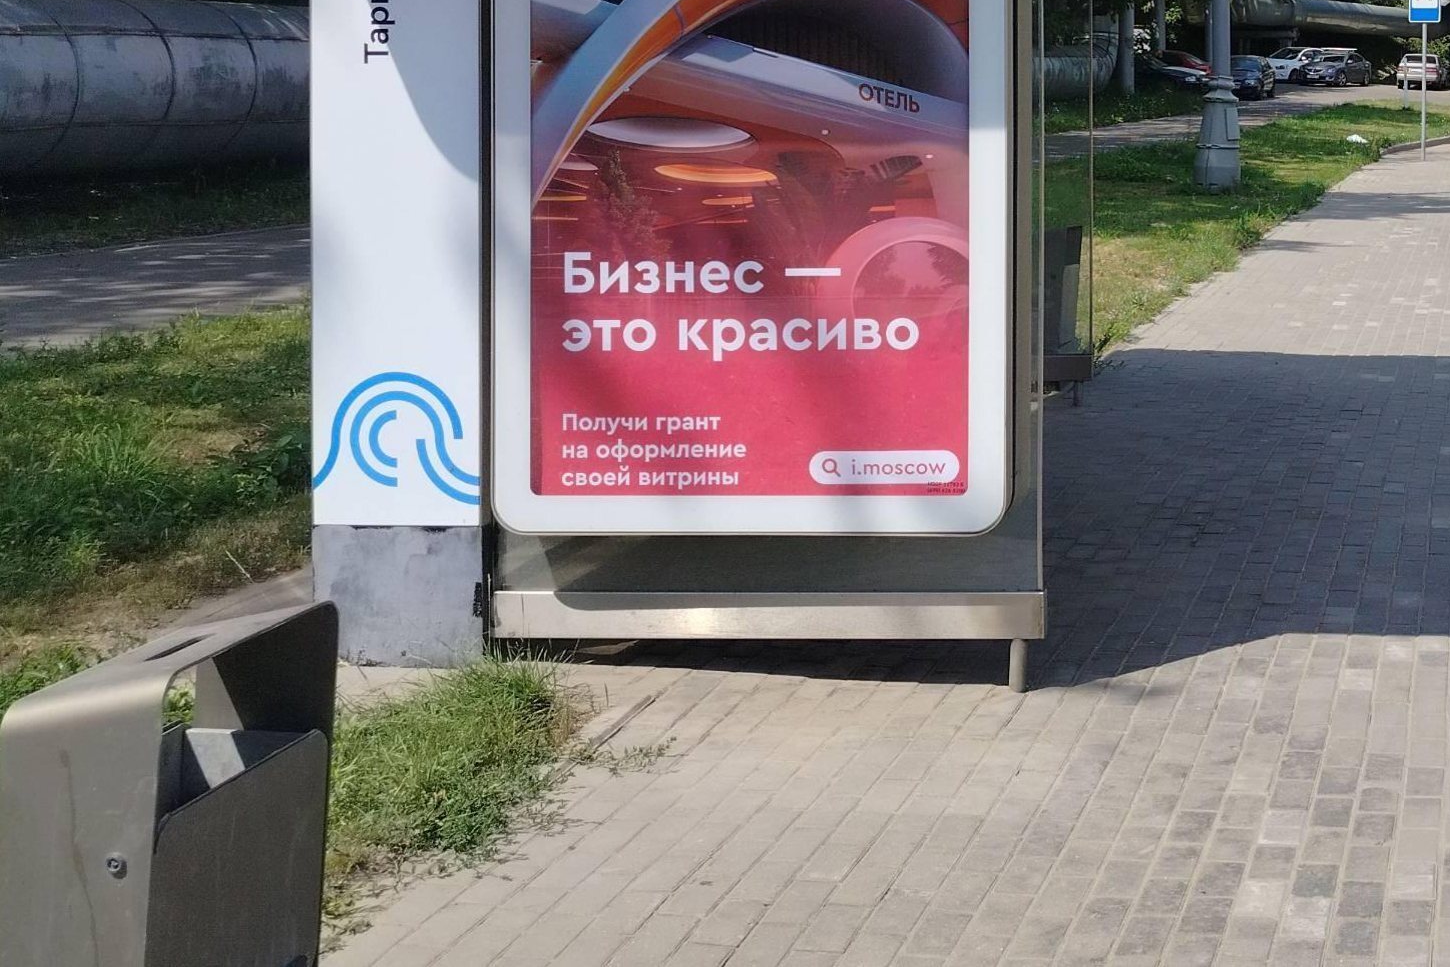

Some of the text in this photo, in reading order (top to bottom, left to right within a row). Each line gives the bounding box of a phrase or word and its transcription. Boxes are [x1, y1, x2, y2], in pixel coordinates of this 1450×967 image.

[859, 83, 920, 113] ОТЕЛЬ
[564, 251, 764, 294] Бизнес
[562, 318, 920, 362] это красиво
[562, 414, 721, 434] Получи грант
[562, 439, 747, 462] на оформление
[562, 466, 739, 491] своей витрины
[851, 458, 946, 475] i.moscow
